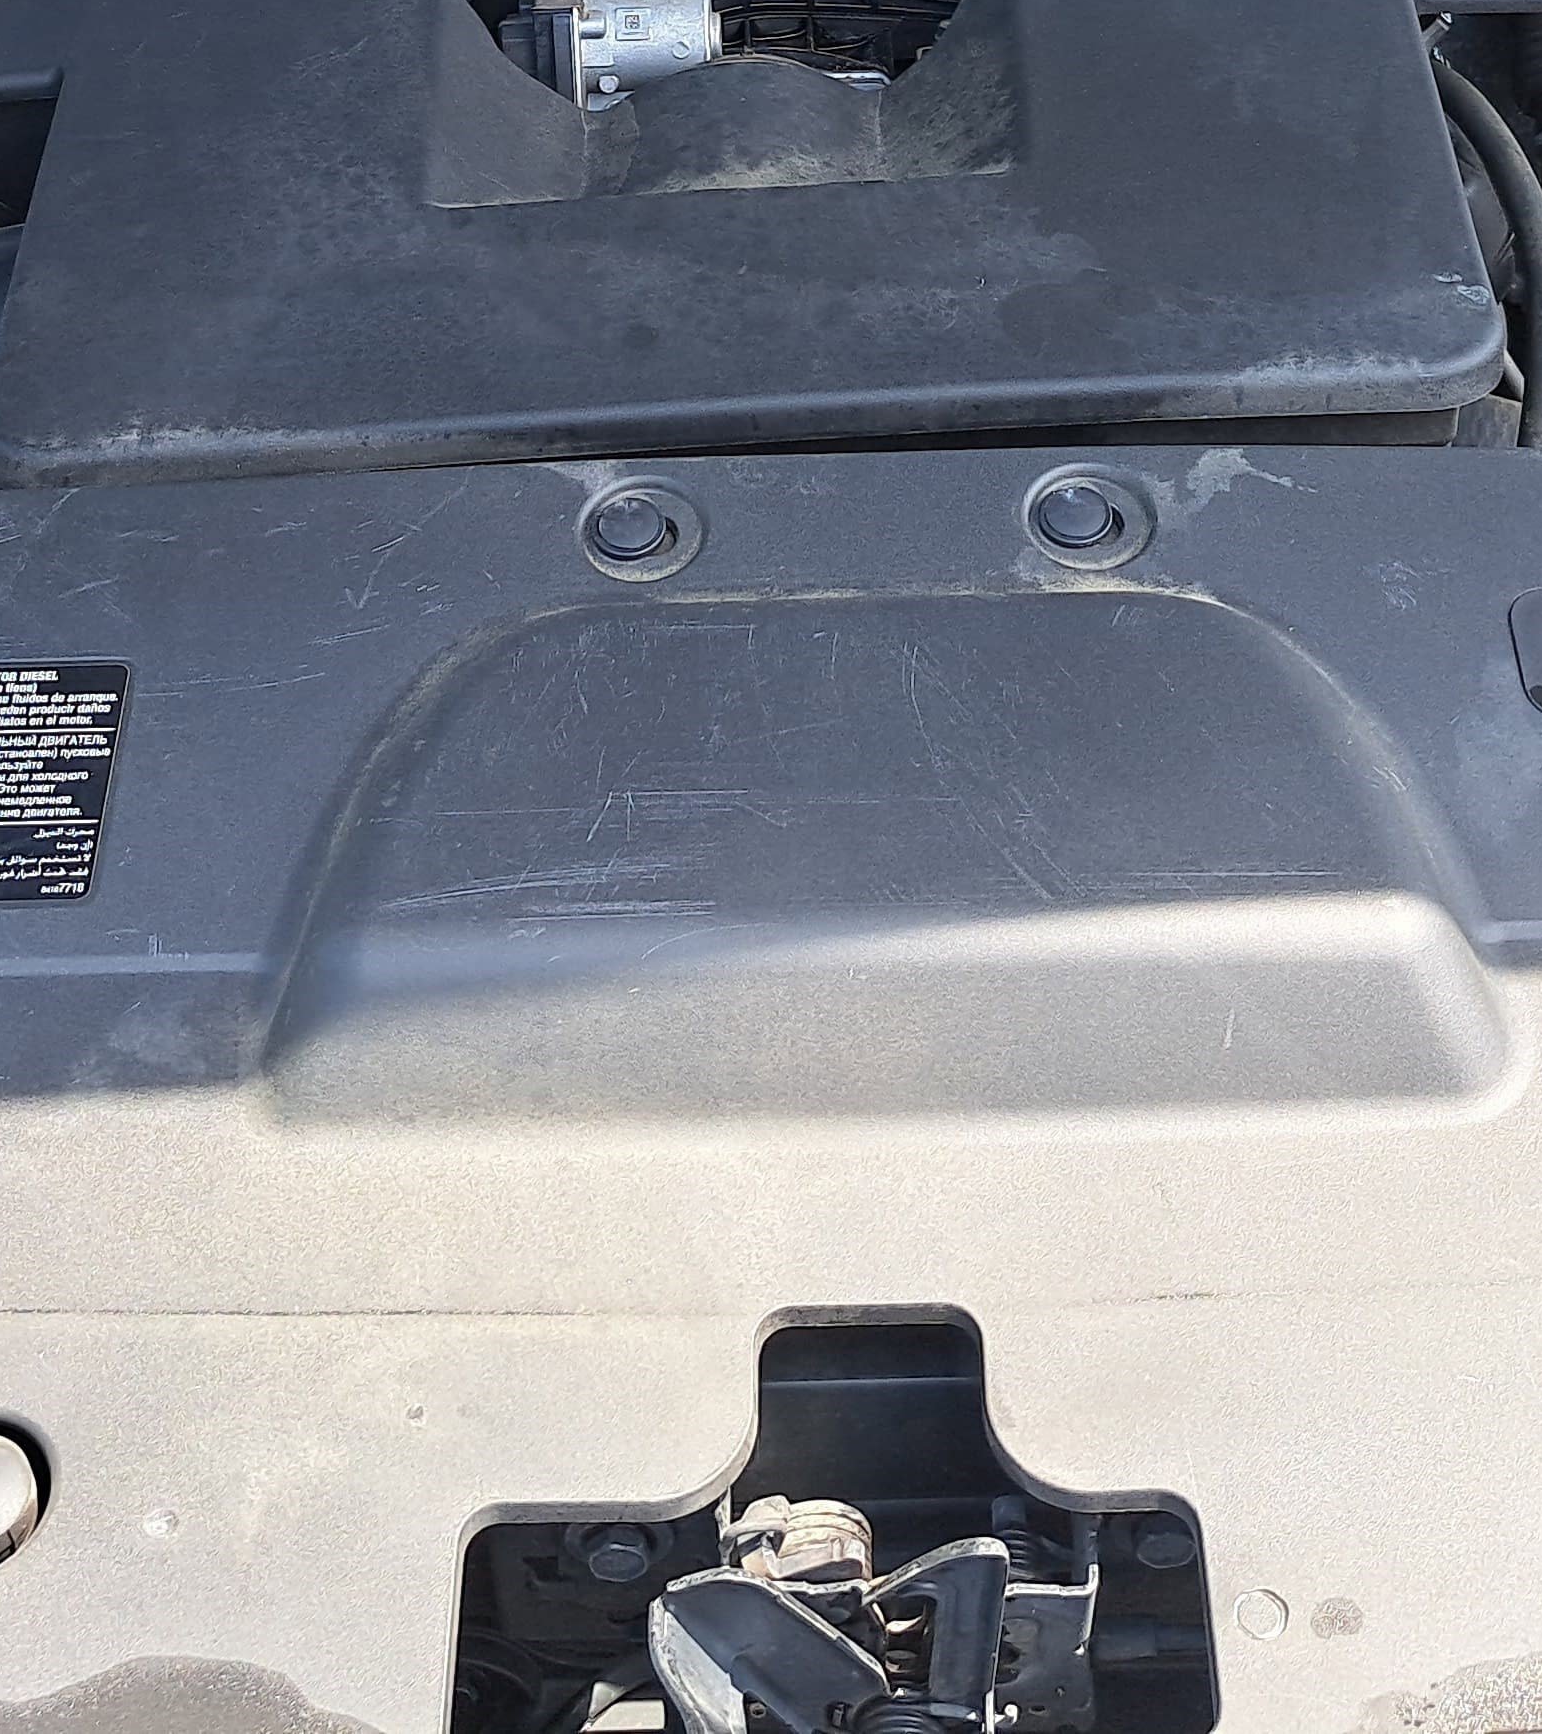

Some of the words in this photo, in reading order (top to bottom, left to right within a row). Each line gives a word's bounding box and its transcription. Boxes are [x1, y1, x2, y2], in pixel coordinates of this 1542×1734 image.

[19, 671, 58, 681] DIESEL
[6, 683, 38, 693] tiene)
[12, 694, 48, 704] fluidos
[51, 693, 65, 703] de
[67, 694, 118, 703] arranque.
[29, 705, 75, 716] producir
[77, 704, 111, 713] daños
[29, 718, 43, 726] en
[46, 716, 56, 725] el
[38, 735, 107, 747] ДВИГАТЕЛЬ
[7, 773, 29, 782] для
[31, 772, 89, 781] холодного
[21, 784, 56, 793] может
